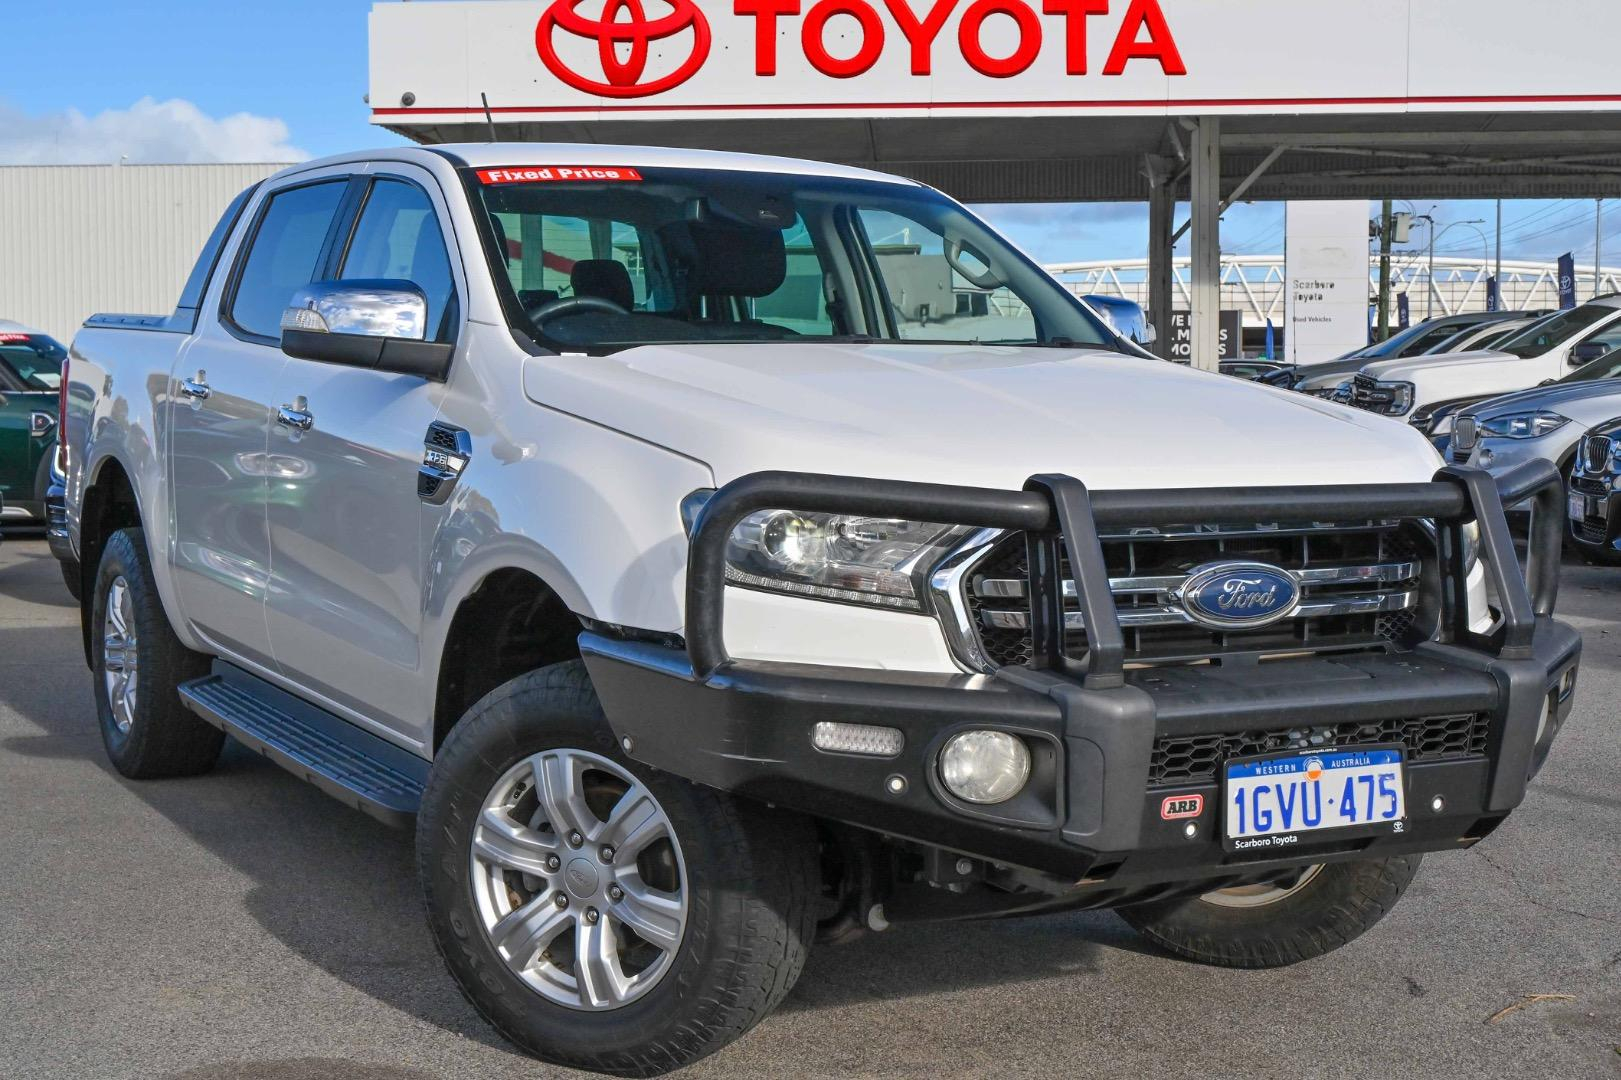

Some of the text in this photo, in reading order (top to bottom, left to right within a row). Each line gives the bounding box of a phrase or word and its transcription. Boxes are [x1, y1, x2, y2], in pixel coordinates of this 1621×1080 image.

[734, 0, 1187, 78] TOYOTA
[487, 168, 620, 182] Fixed Price
[1293, 292, 1323, 303] Toyota
[1218, 578, 1277, 609] Ford
[1255, 757, 1371, 775] WESTERN AUSTRALIA
[1167, 800, 1198, 814] ARB
[1235, 835, 1298, 849] Scarboro Toyota
